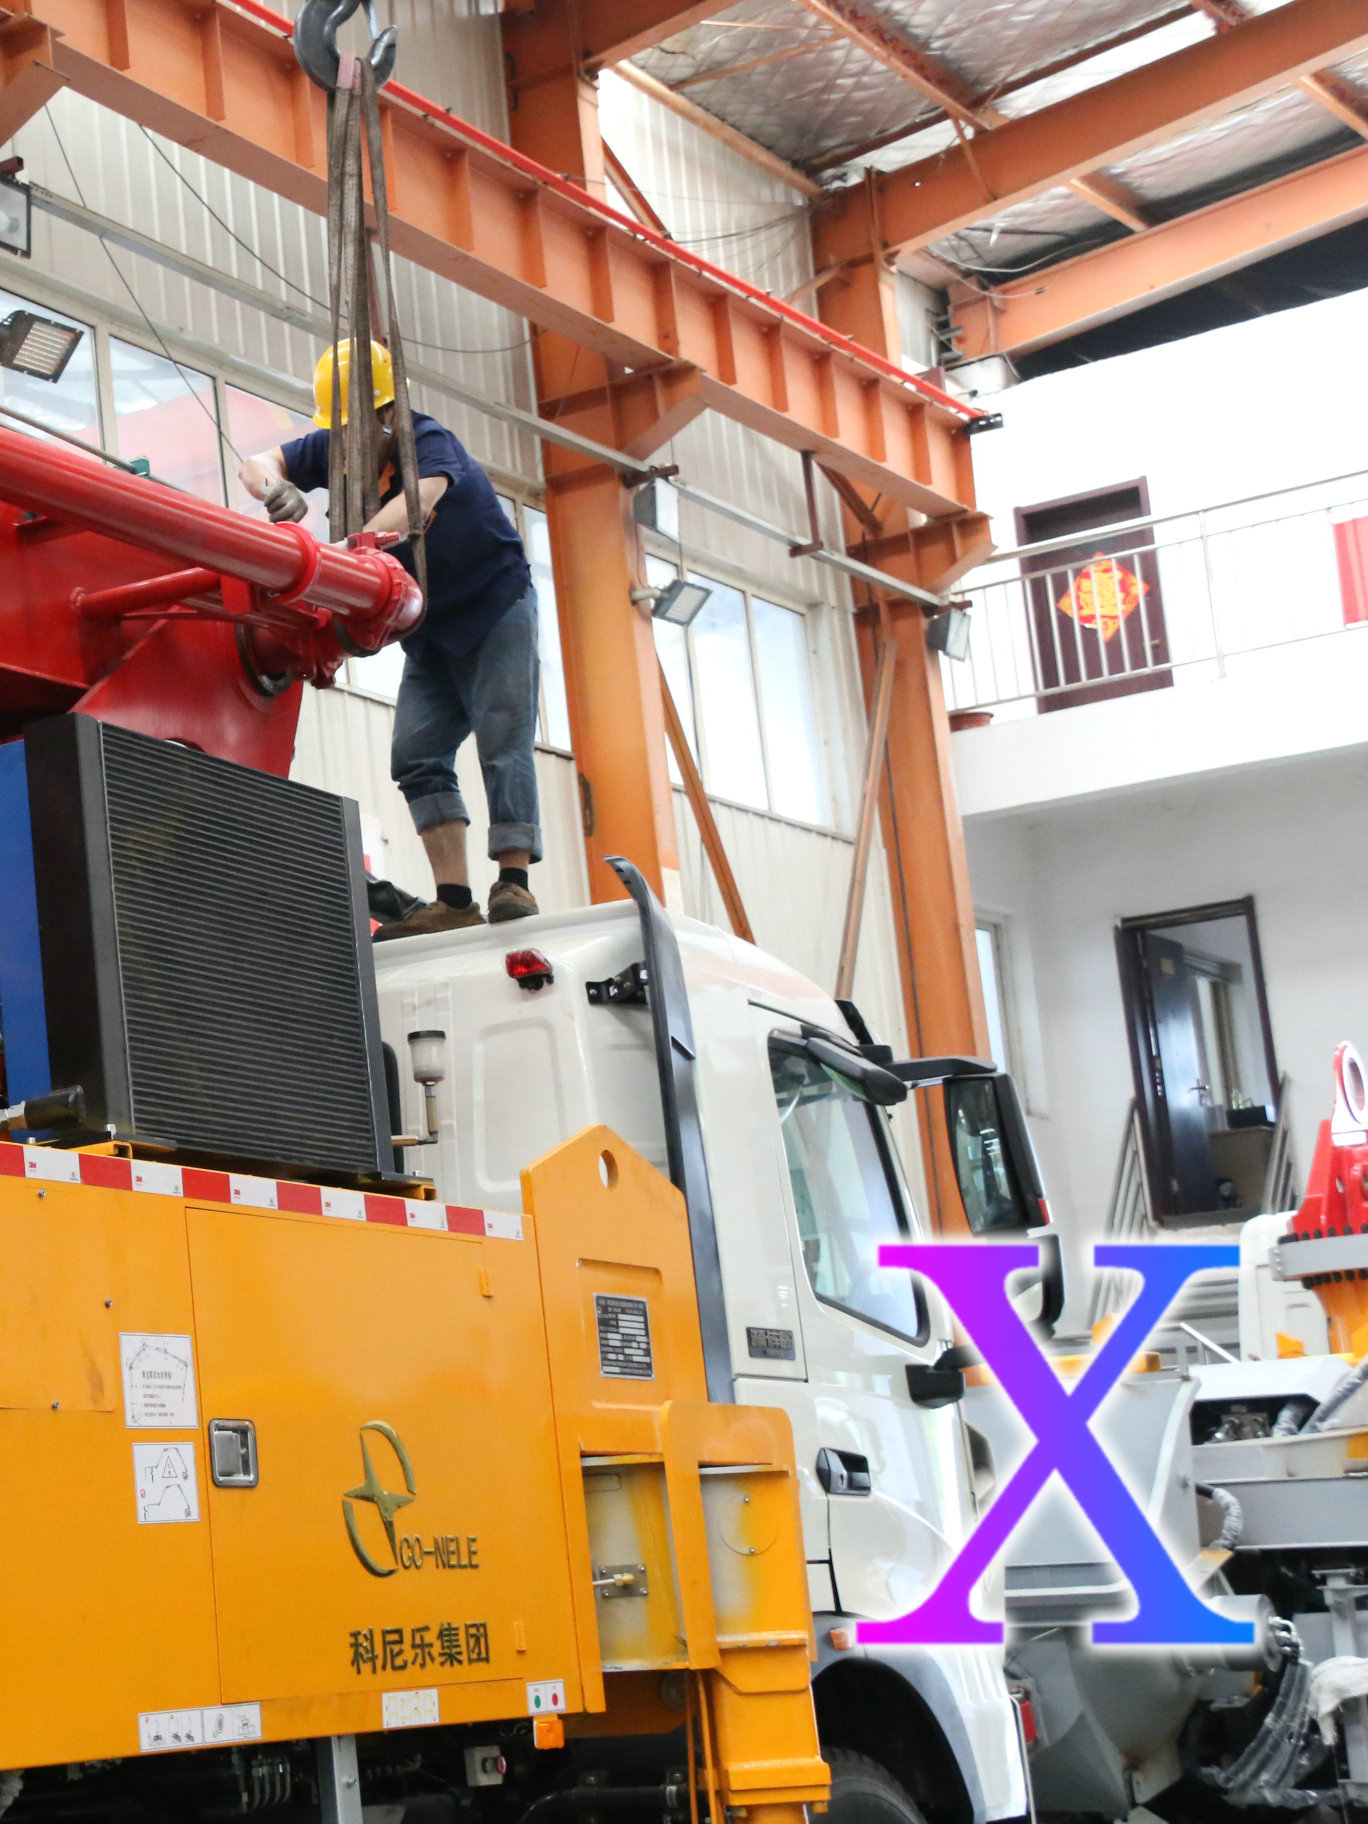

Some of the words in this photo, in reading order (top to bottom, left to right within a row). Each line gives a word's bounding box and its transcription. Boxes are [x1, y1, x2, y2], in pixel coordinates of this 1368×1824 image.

[399, 1535, 479, 1569] CO-NELE
[349, 1622, 490, 1675] 科尼乐集团
